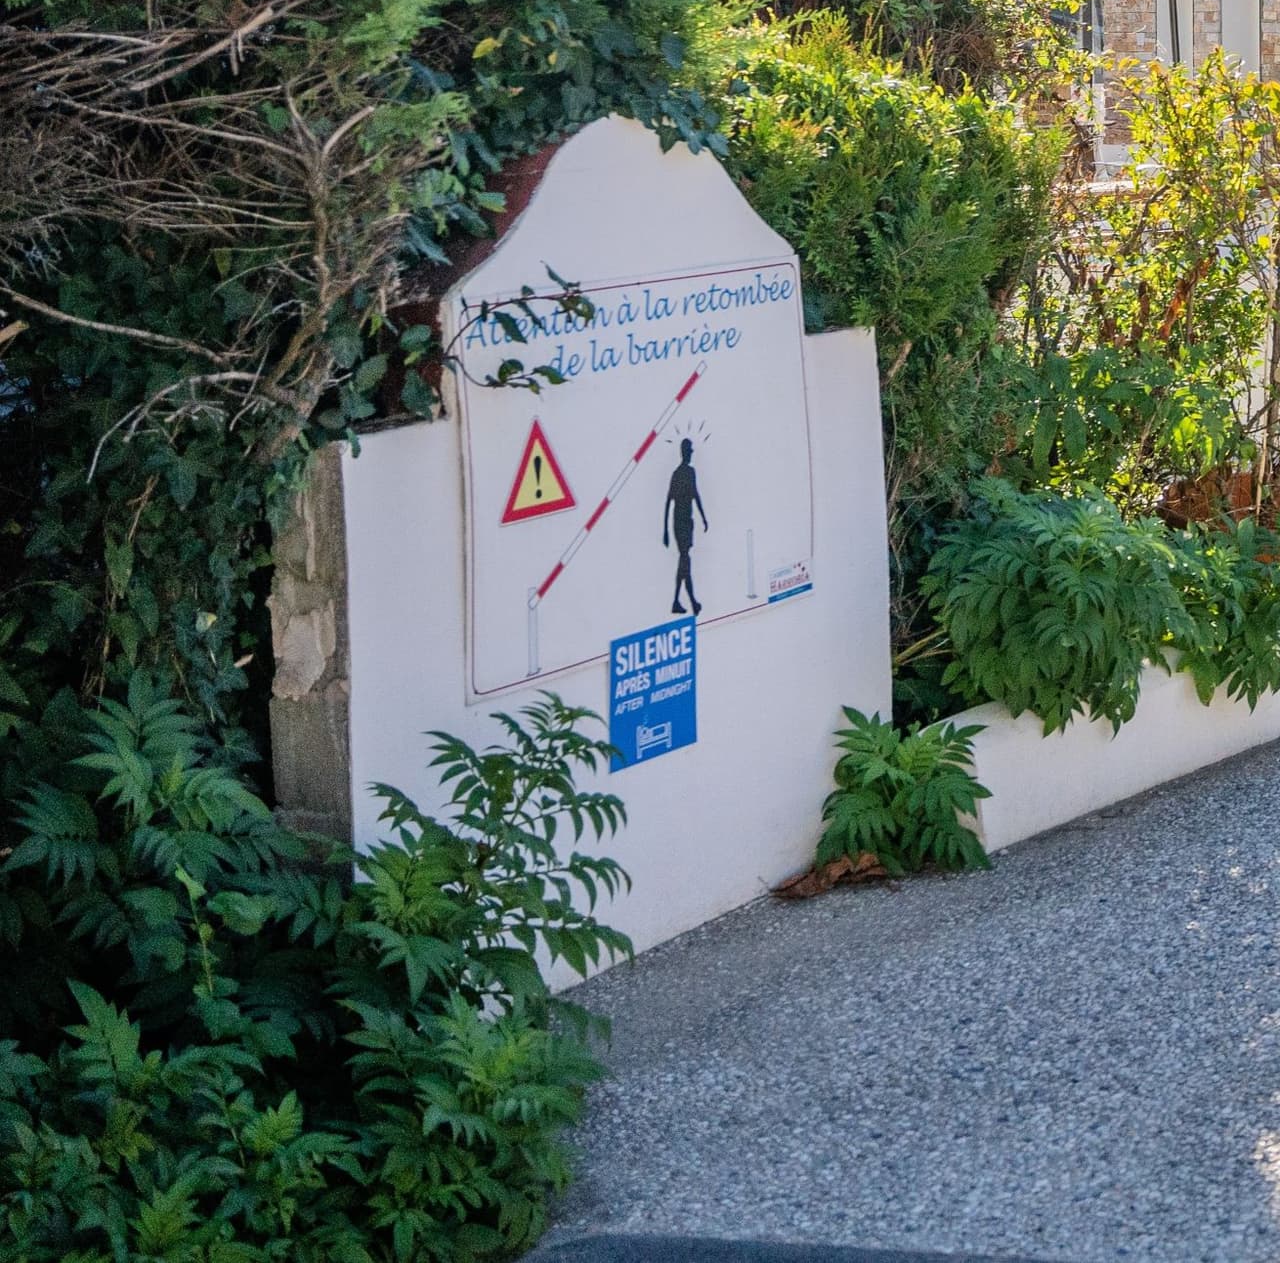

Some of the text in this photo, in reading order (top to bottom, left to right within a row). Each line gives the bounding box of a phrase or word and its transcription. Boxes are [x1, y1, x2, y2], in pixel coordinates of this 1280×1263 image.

[465, 273, 794, 350] Atention à la retombée
[549, 323, 742, 377] de la barrière
[615, 625, 692, 676] SILENCE
[614, 679, 692, 716] AFTER MIDNIGHT
[615, 658, 692, 699] APRÈS MINUIT
